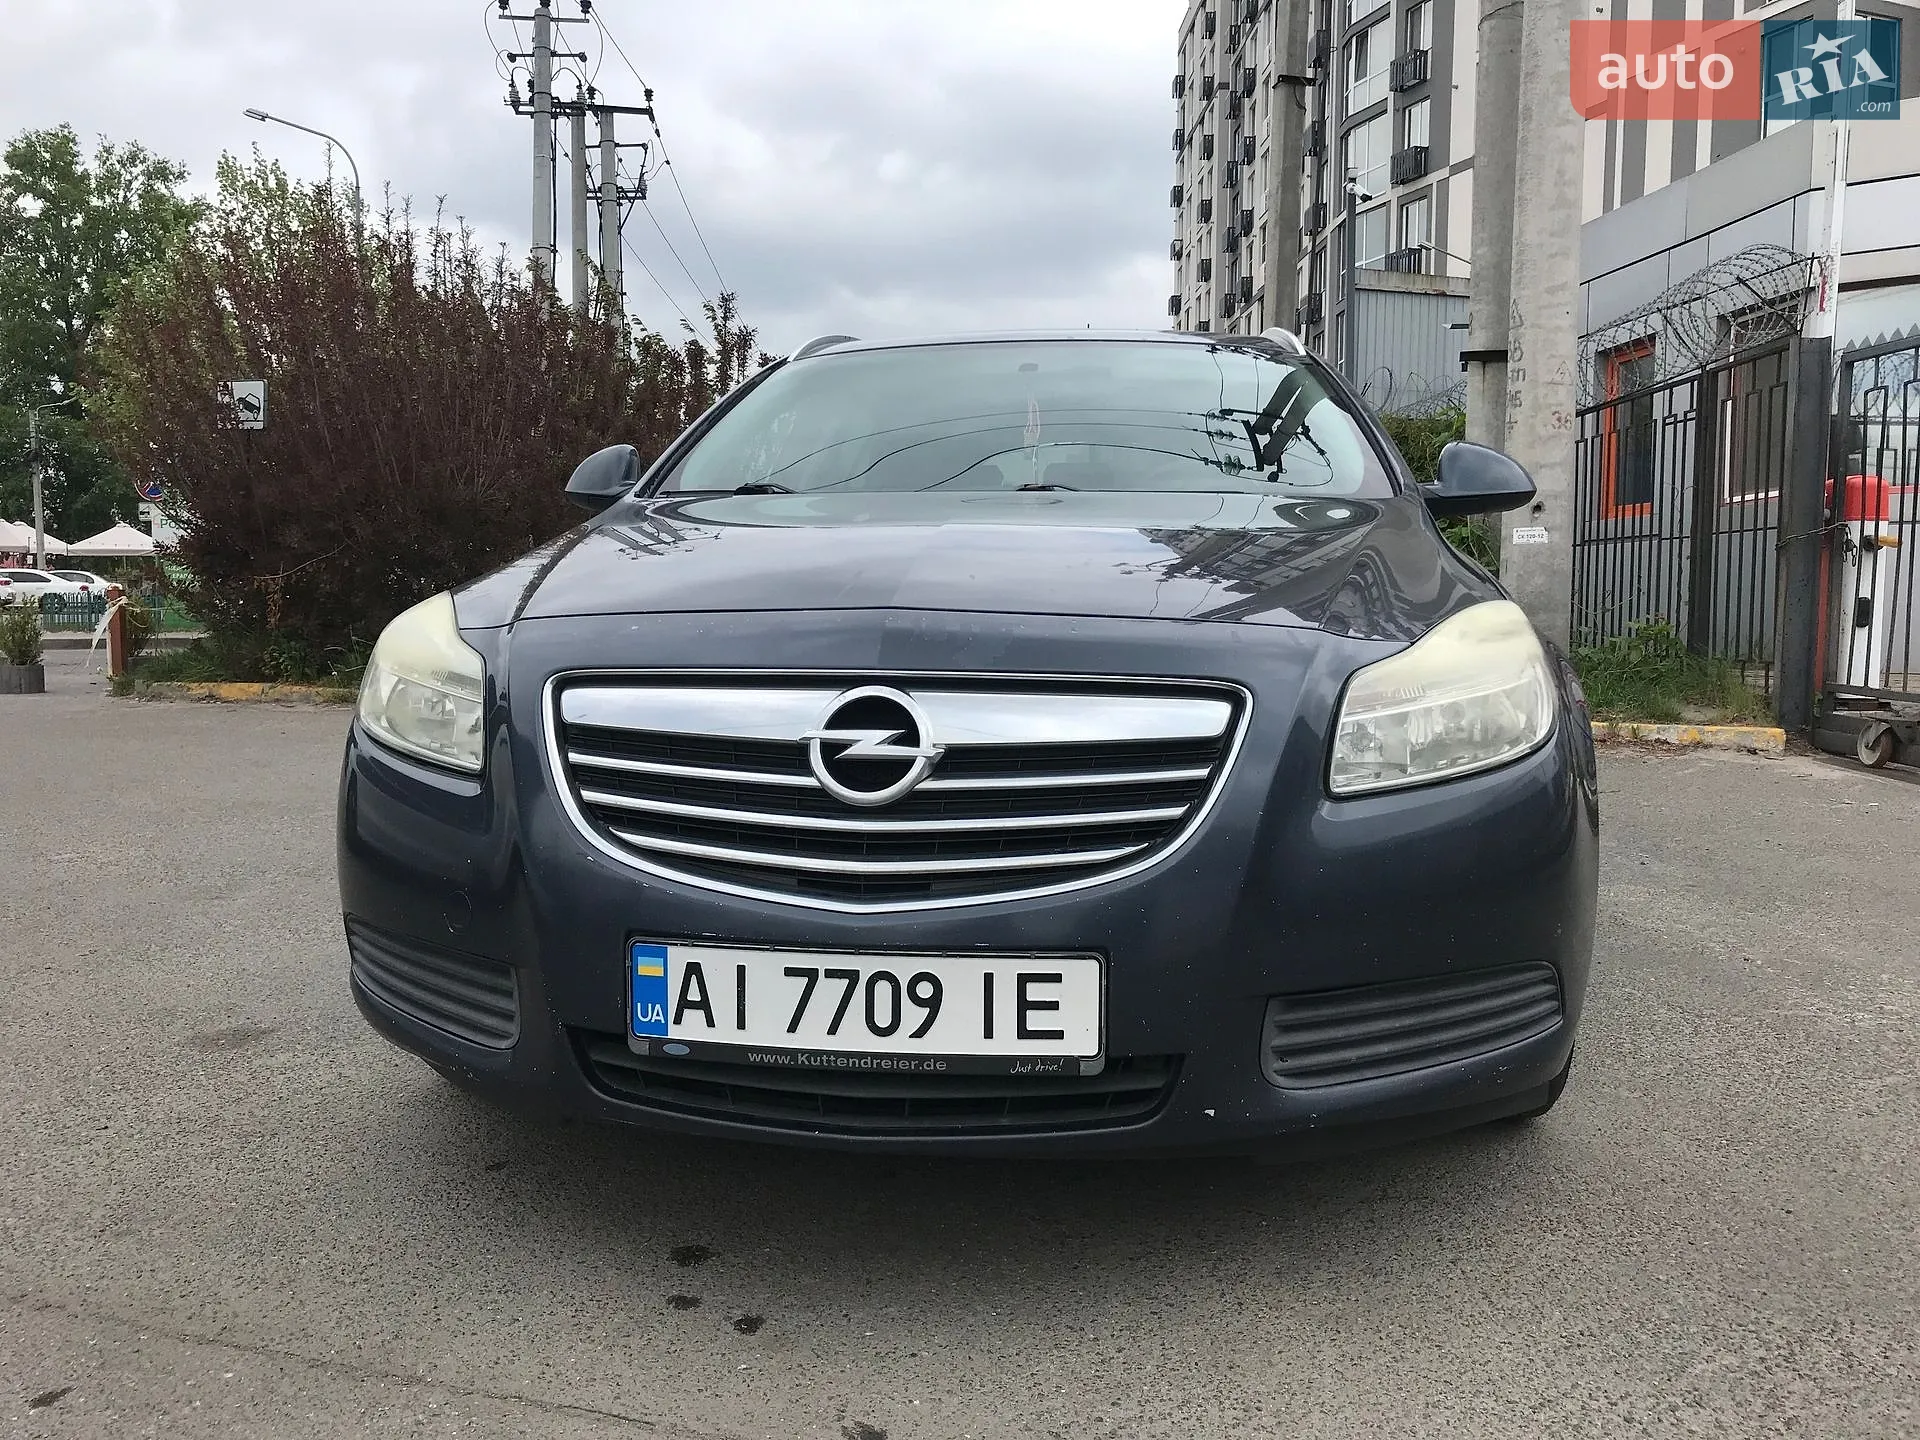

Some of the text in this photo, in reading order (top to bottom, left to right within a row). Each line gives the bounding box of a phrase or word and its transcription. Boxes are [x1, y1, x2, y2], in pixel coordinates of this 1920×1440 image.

[672, 961, 1066, 1041] AI 7709 IE
[637, 1001, 665, 1024] UA
[747, 1052, 947, 1071] www.Kuttendreier.de
[1010, 1058, 1065, 1074] Just drive!
